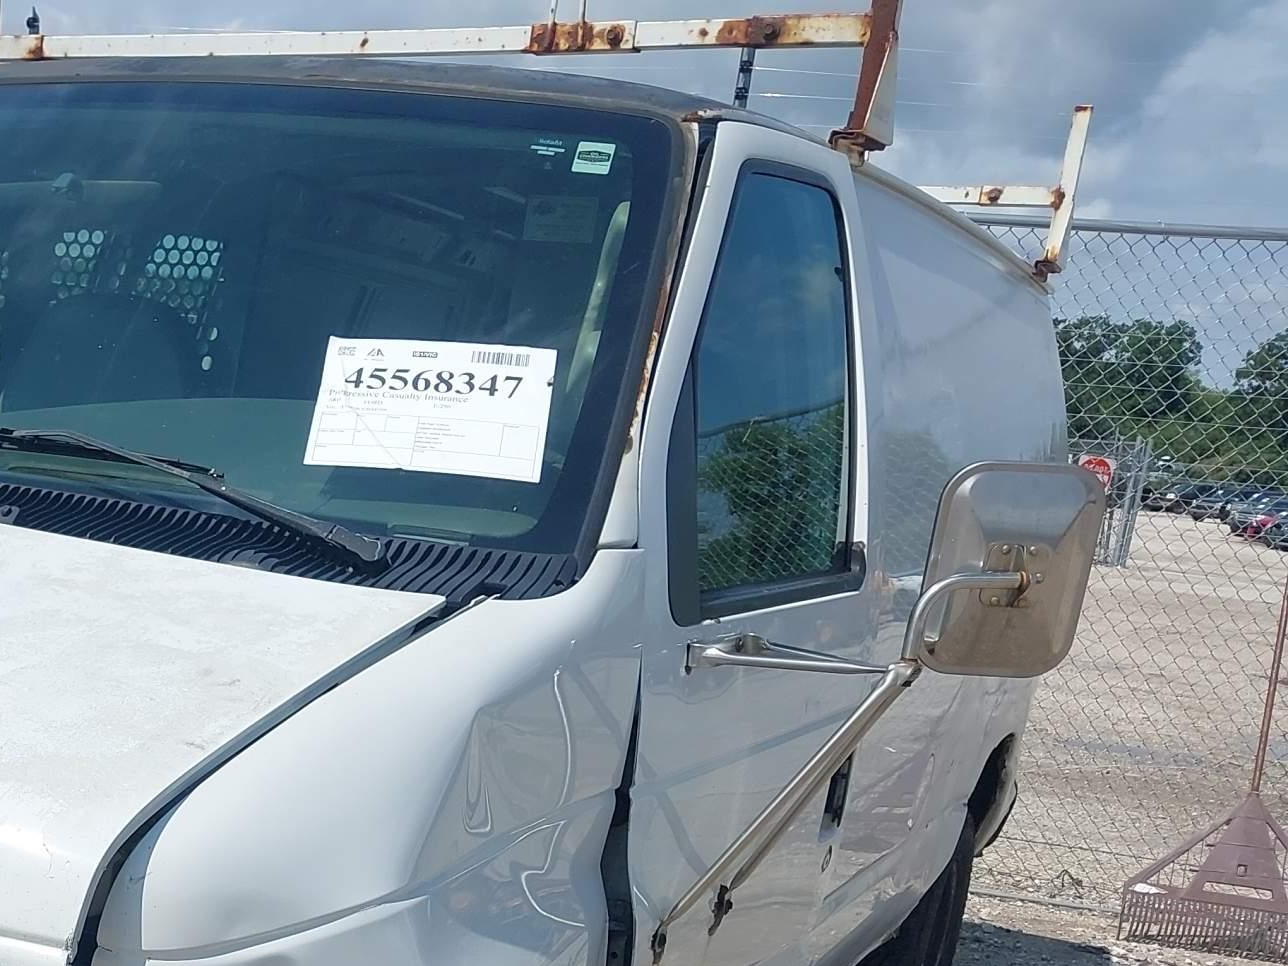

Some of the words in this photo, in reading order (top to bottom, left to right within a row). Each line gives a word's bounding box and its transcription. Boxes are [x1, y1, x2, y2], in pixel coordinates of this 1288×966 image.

[343, 367, 524, 399] 45568347
[382, 391, 421, 402] Casualty
[424, 392, 469, 403] Insurance
